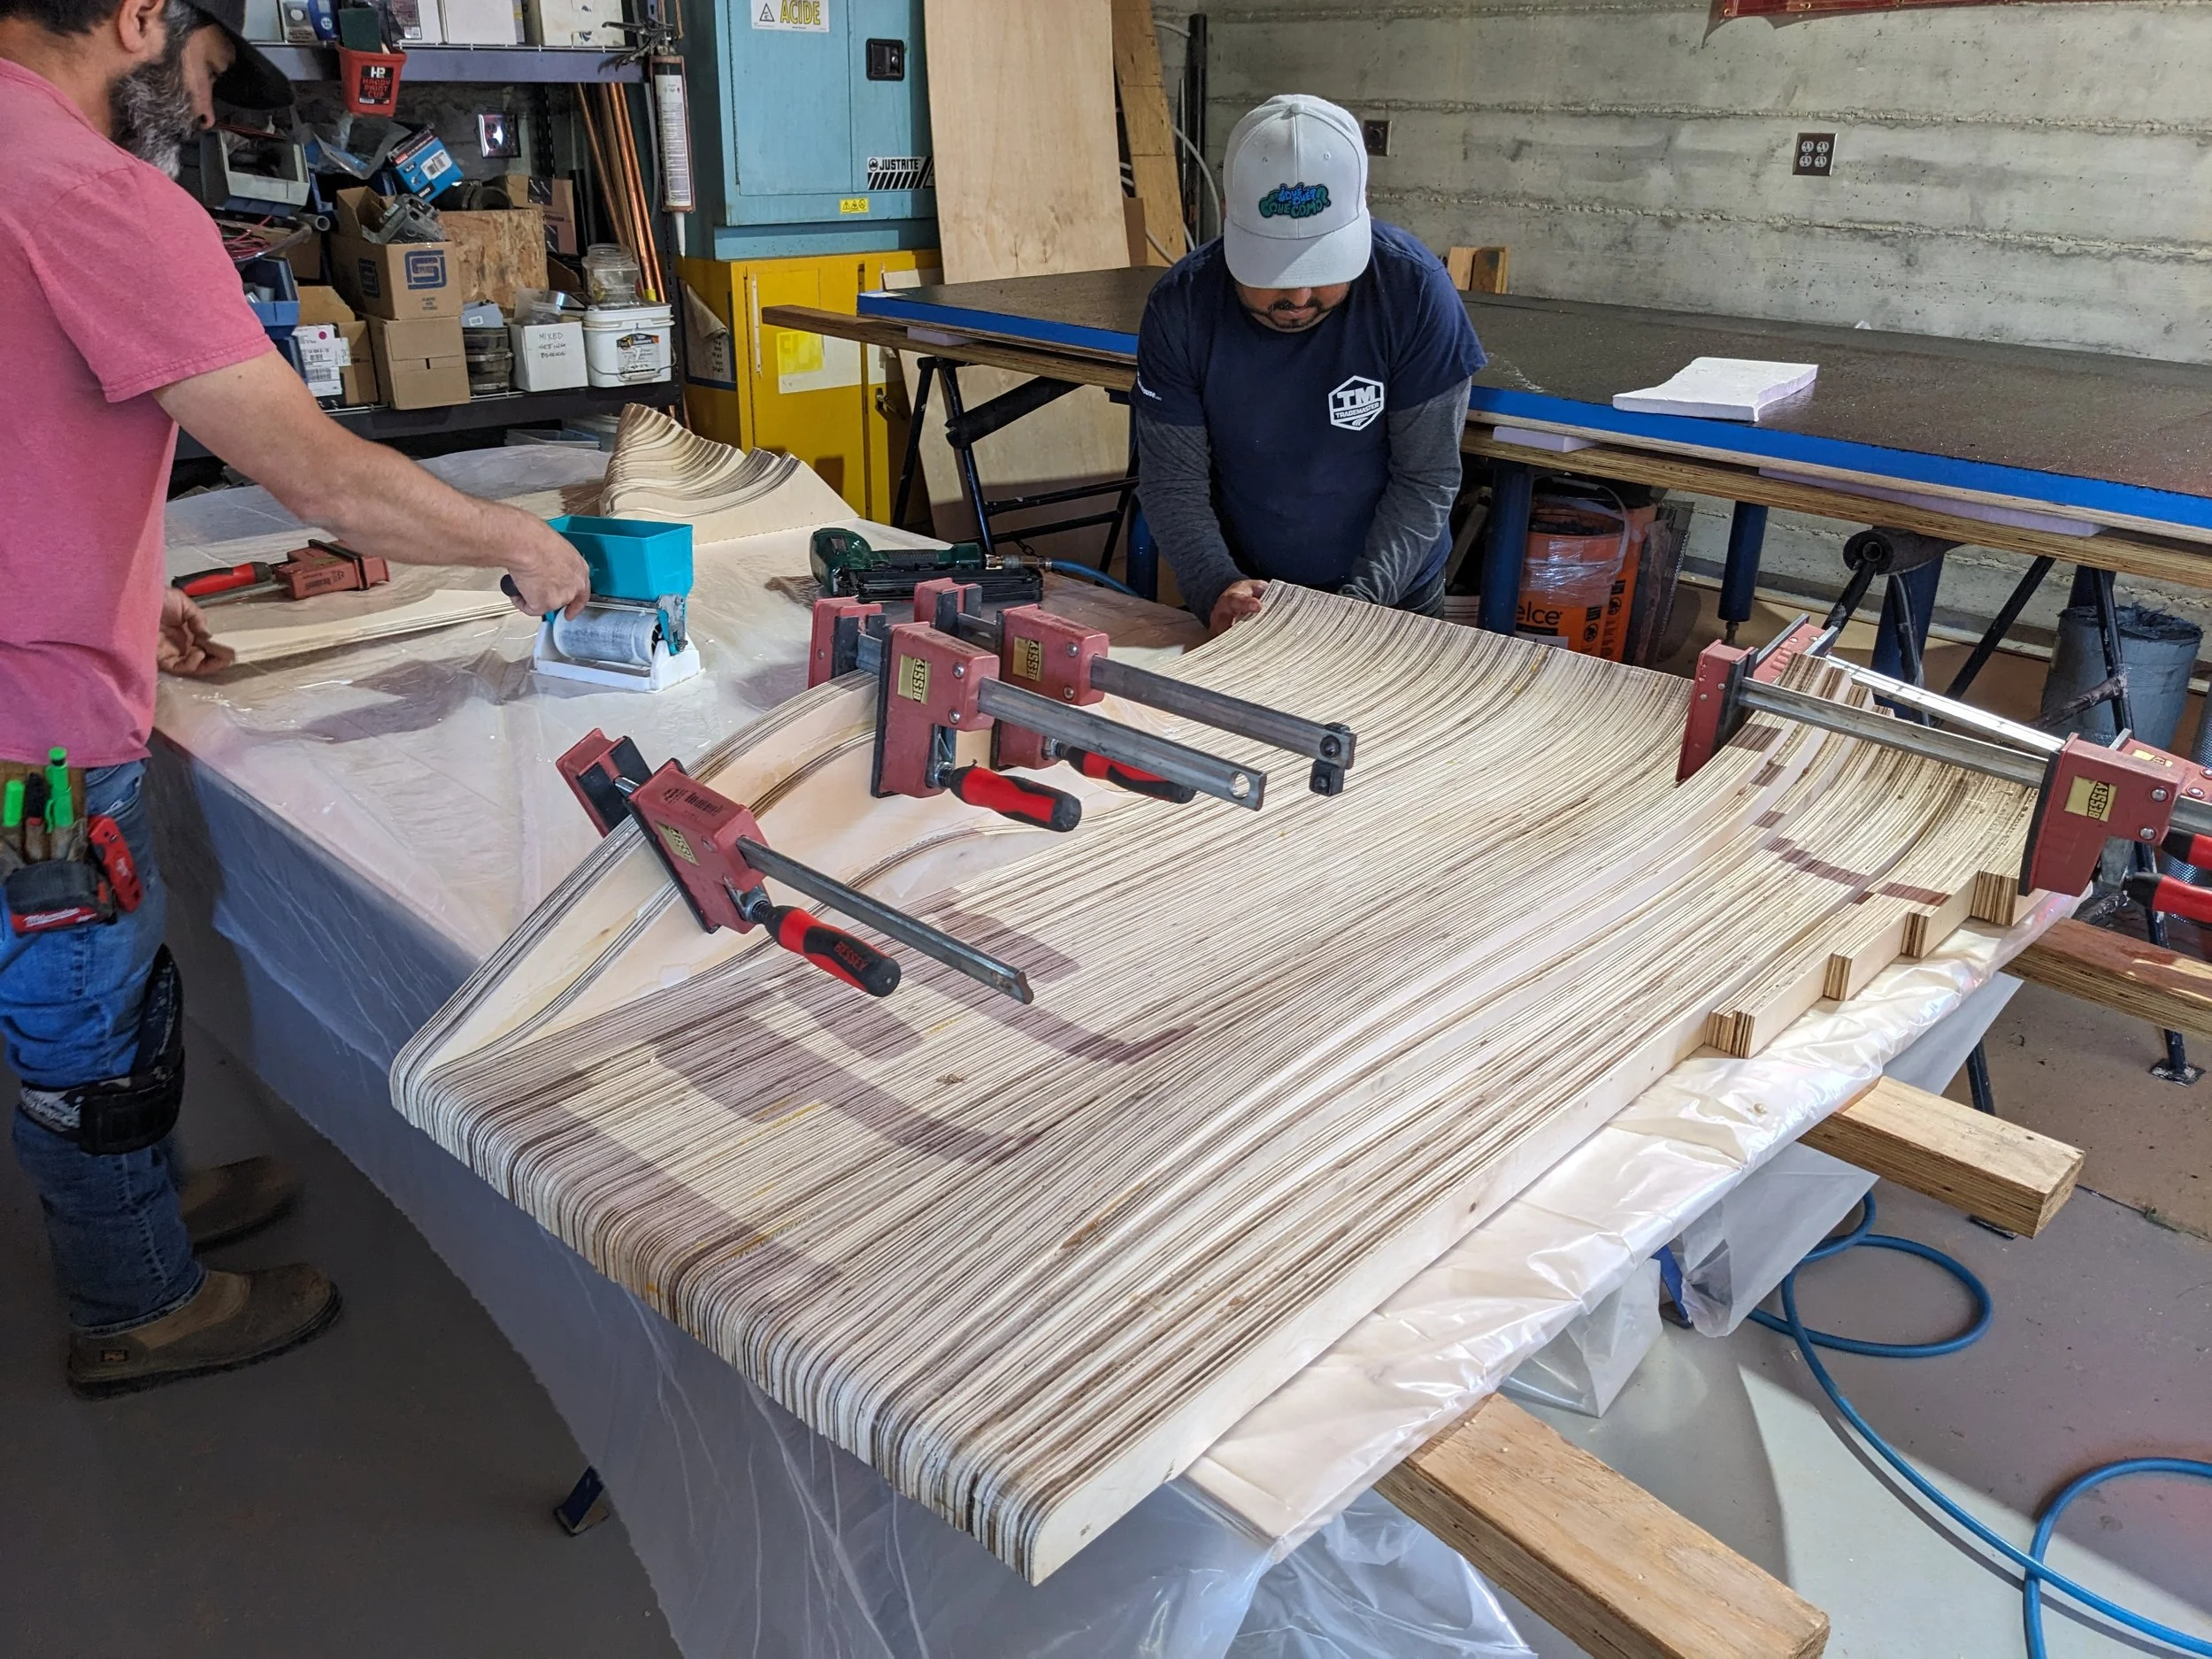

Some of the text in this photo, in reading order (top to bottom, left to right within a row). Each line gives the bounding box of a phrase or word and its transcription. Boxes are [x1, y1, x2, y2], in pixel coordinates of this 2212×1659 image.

[780, 0, 821, 26] ACIDE
[879, 158, 918, 171] JUSTRITE
[539, 332, 564, 341] MIXED
[1337, 385, 1376, 409] TM
[1335, 402, 1379, 419] TRADEMASTER
[1027, 641, 1039, 680] BESSEY
[913, 657, 926, 701] BESSEY
[2088, 782, 2109, 819] BESSEY
[833, 940, 869, 972] BESSEY
